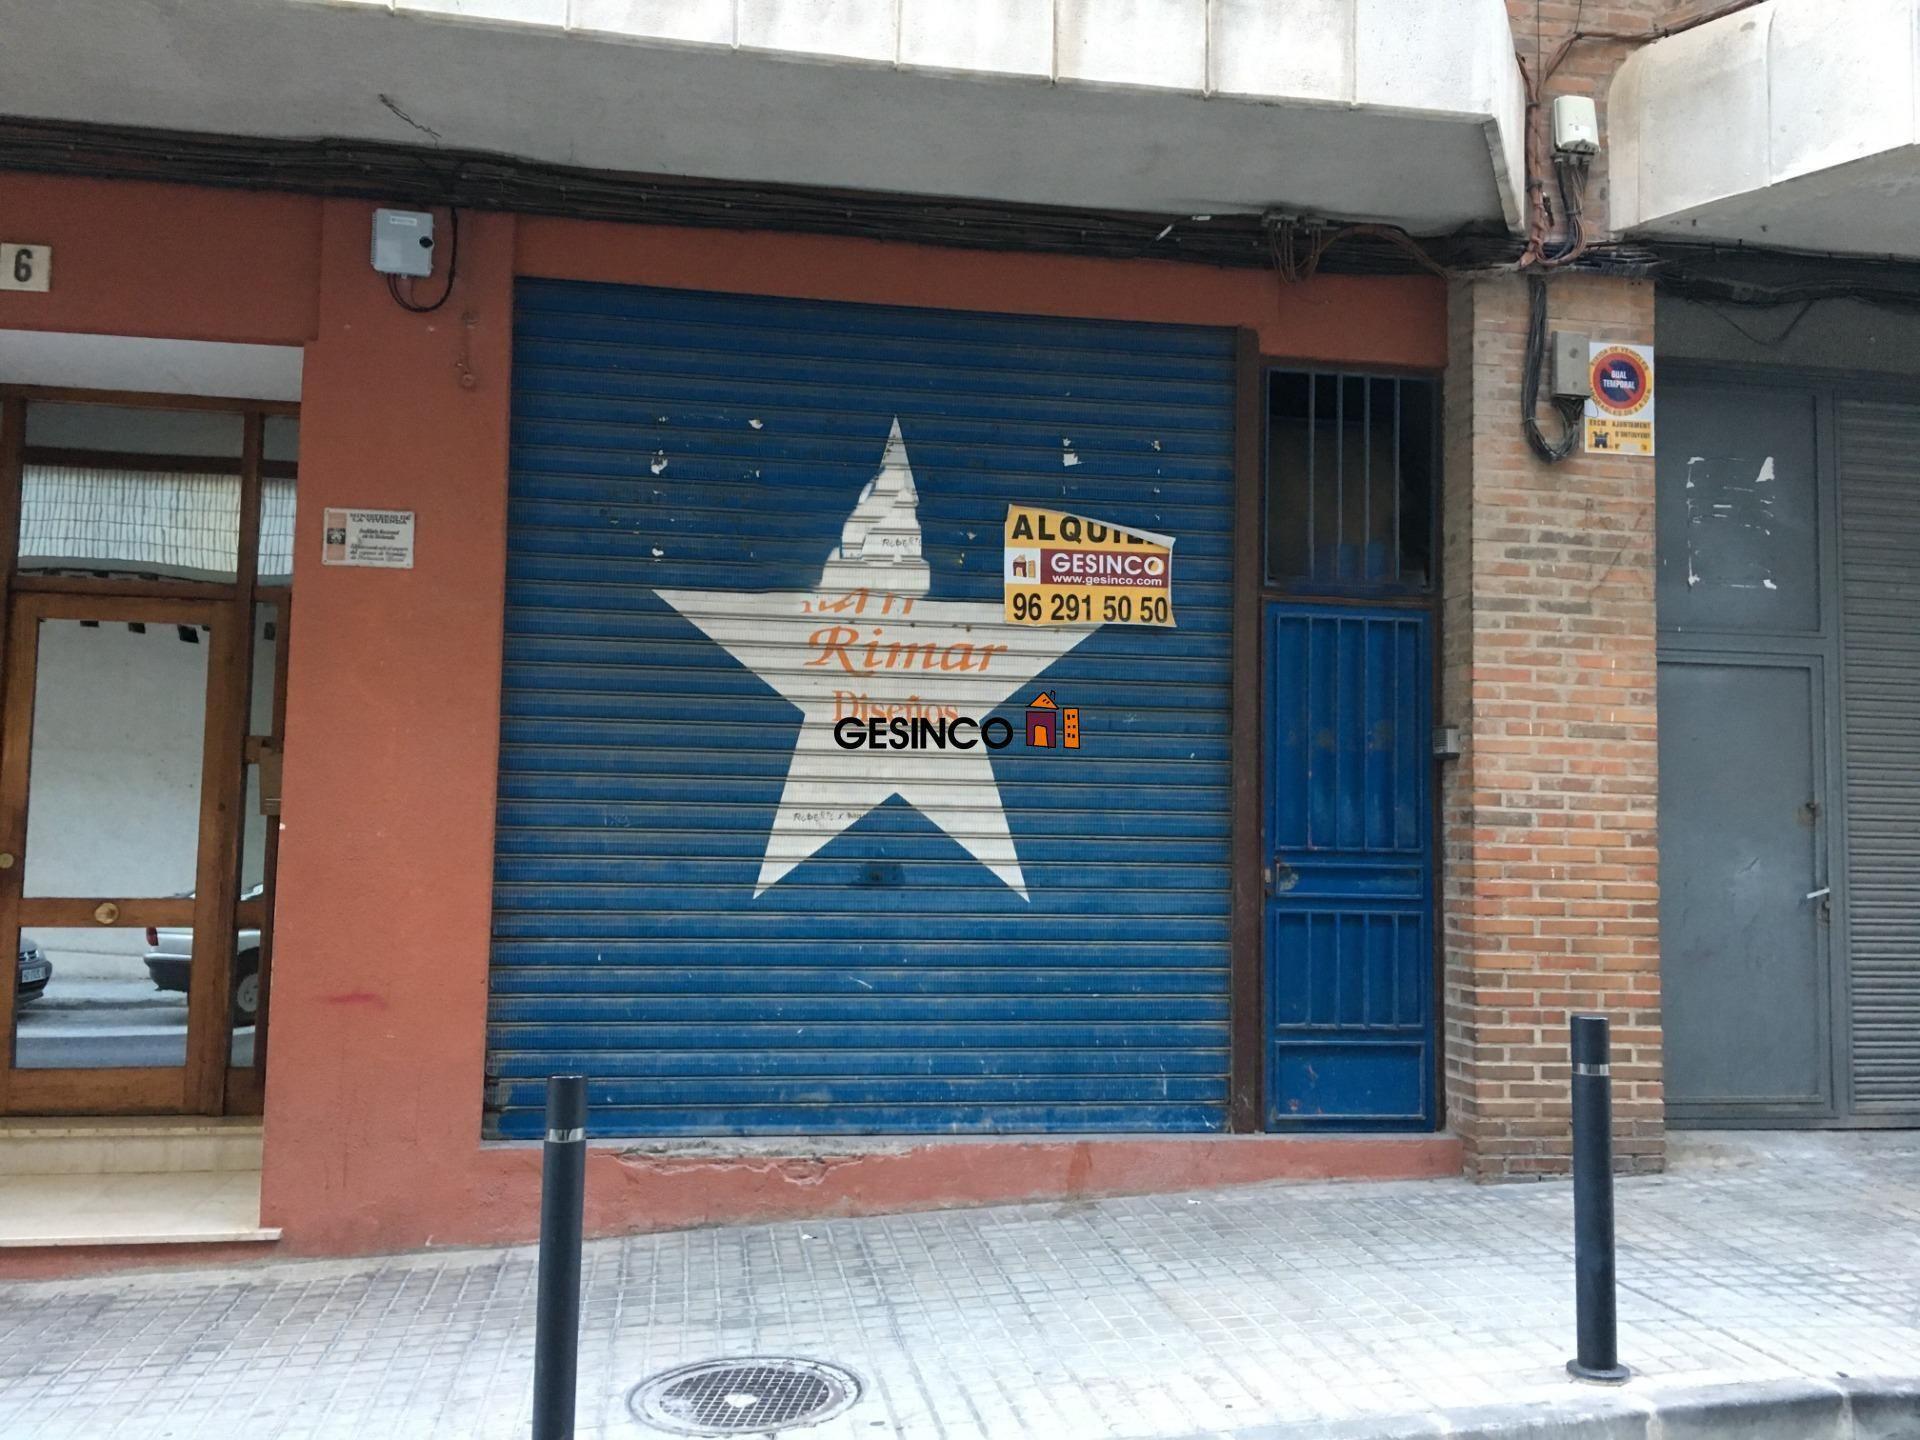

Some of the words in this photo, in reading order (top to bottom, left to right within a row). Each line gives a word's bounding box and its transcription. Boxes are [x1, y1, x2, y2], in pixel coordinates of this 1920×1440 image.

[15, 249, 33, 282] 6
[1603, 379, 1636, 389] TEMPORAL
[1011, 514, 1156, 545] ALQUI
[1051, 552, 1165, 576] GESINCO
[1052, 574, 1162, 586] www.gesinco.com
[1012, 592, 1042, 621] 96
[1050, 593, 1091, 621] 291
[1103, 595, 1132, 622] 50
[1139, 596, 1168, 623] 50
[803, 626, 1008, 677] Rimar
[832, 689, 959, 724] Diseños
